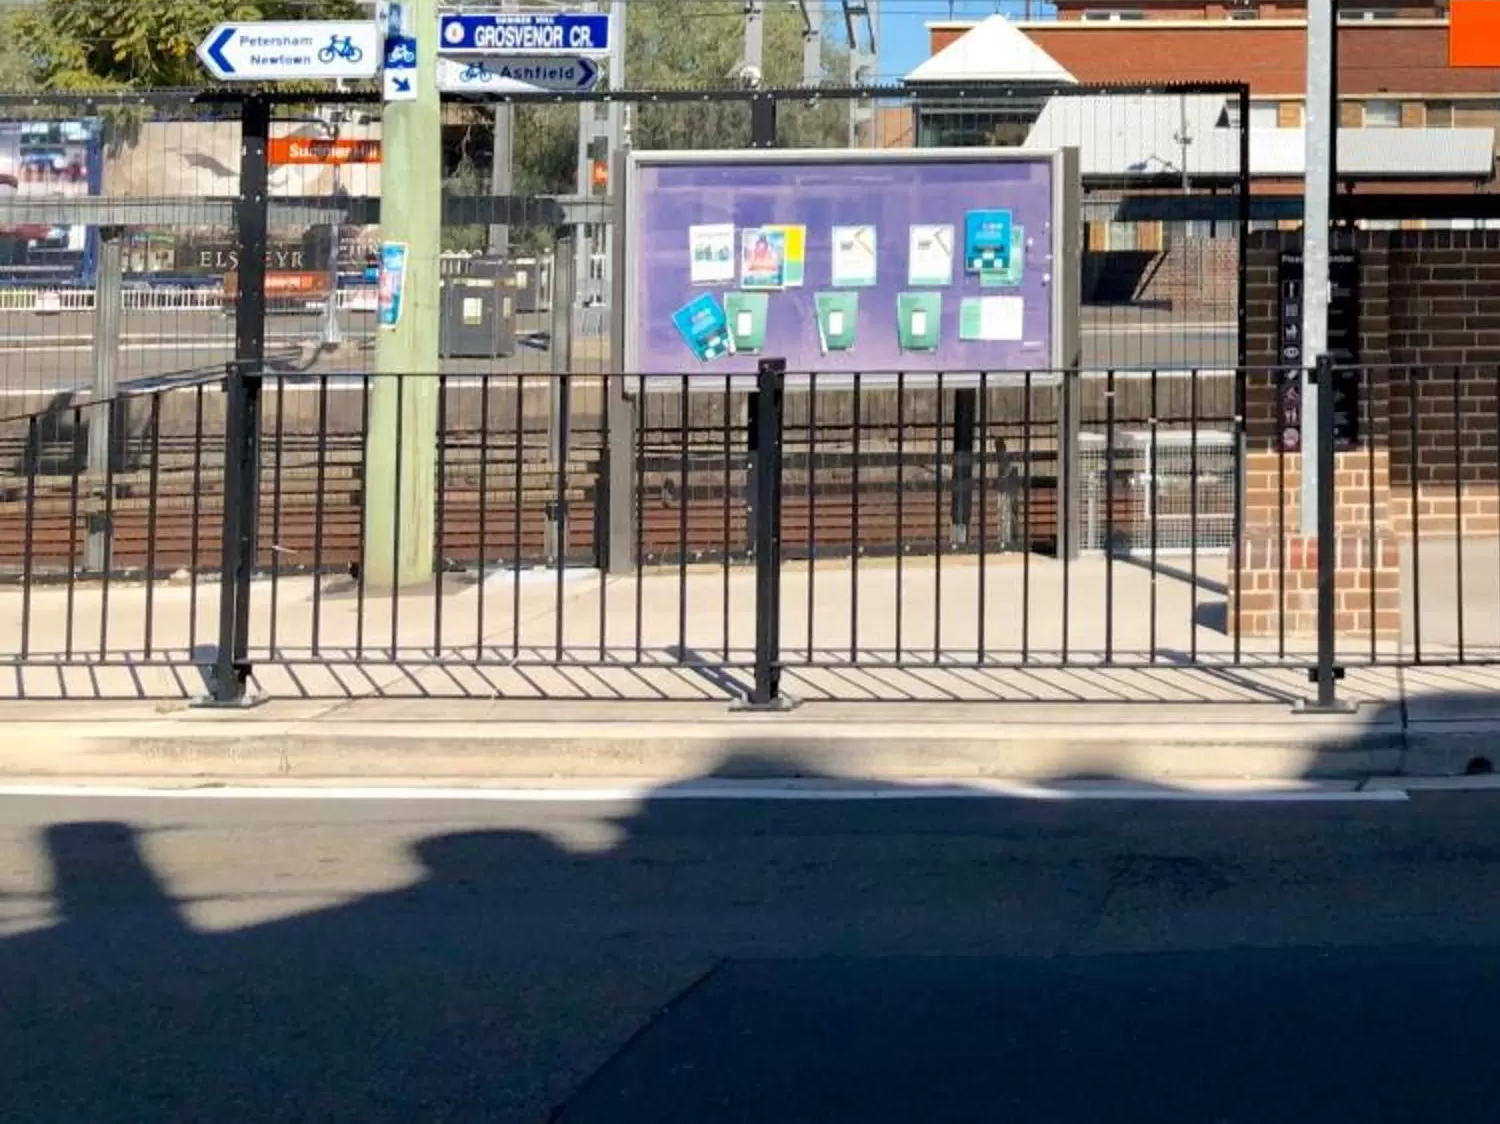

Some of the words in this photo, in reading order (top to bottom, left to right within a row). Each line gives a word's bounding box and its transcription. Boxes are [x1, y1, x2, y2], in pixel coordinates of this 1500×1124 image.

[239, 35, 313, 48] Petersham
[474, 25, 564, 47] GROSVENOR
[250, 54, 312, 66] Newtown
[500, 64, 575, 80] Ashfield
